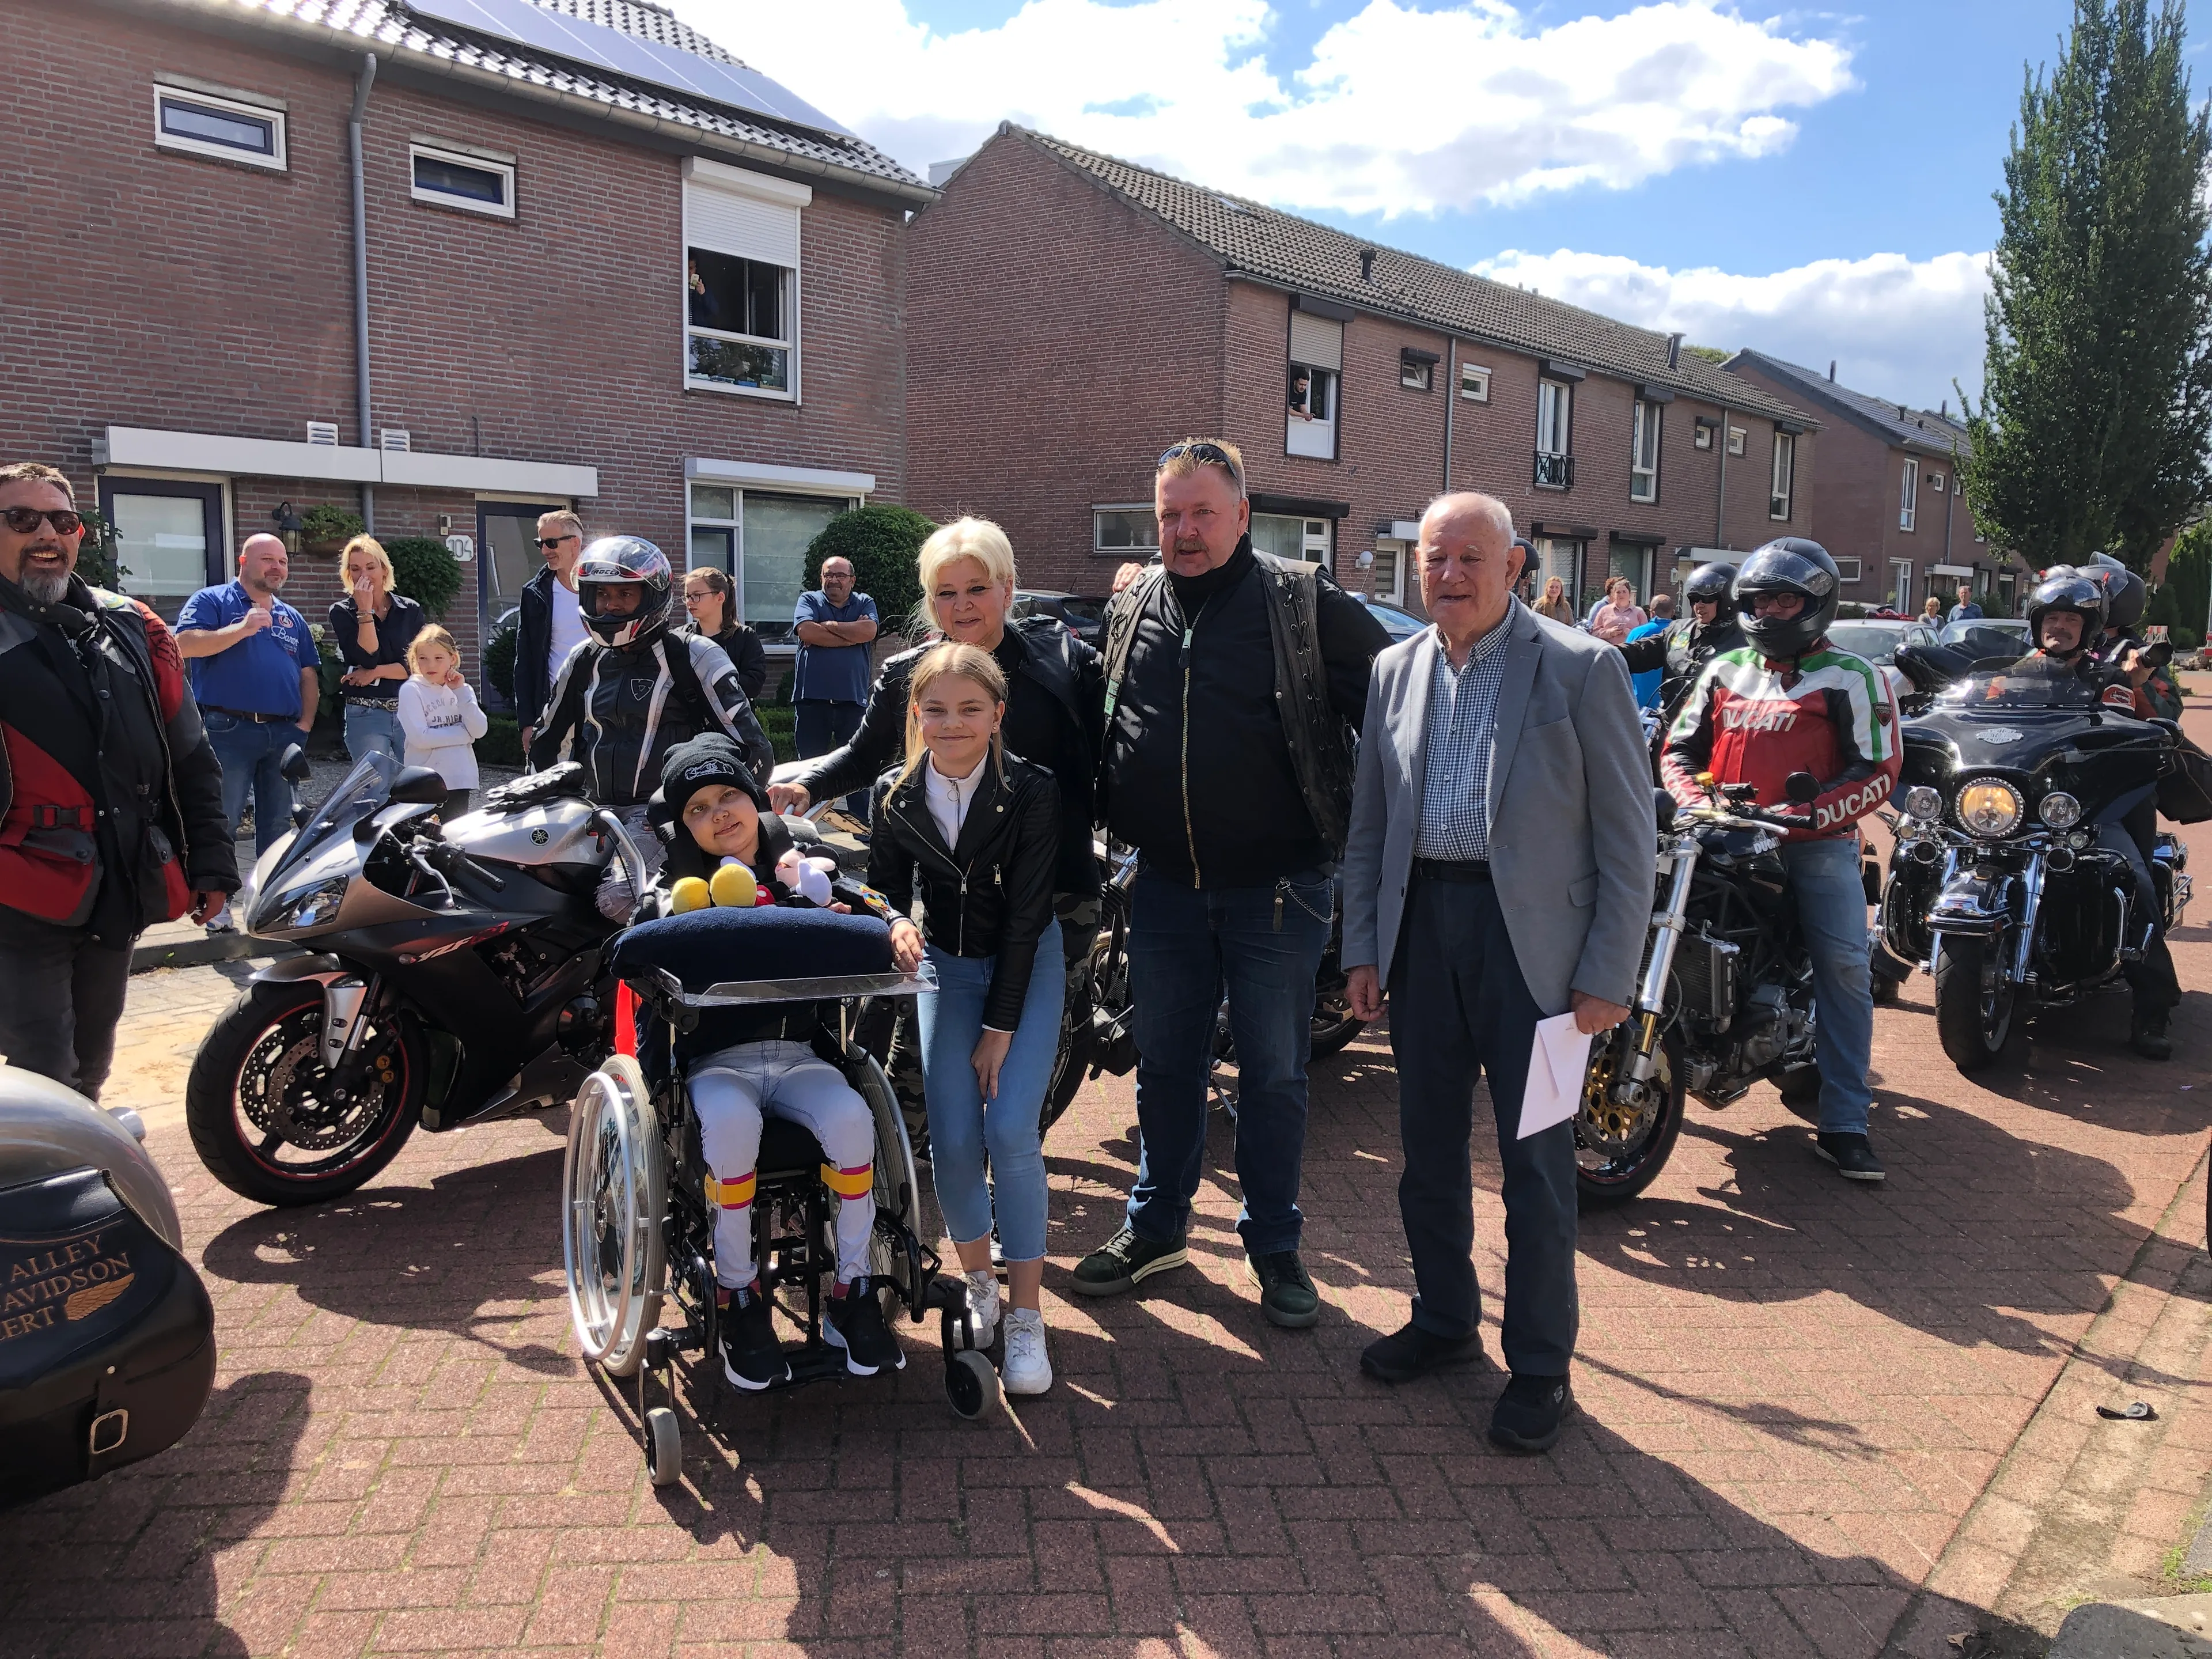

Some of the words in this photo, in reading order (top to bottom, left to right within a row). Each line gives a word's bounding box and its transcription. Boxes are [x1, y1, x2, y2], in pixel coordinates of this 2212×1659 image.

[1722, 709, 1797, 732] DUCATI
[1817, 774, 1891, 830] DUCATI
[418, 936, 473, 963] YZF
[10, 1234, 101, 1283] ALLEY
[0, 1252, 131, 1312] AVIDSON
[0, 1305, 54, 1341] ERT
